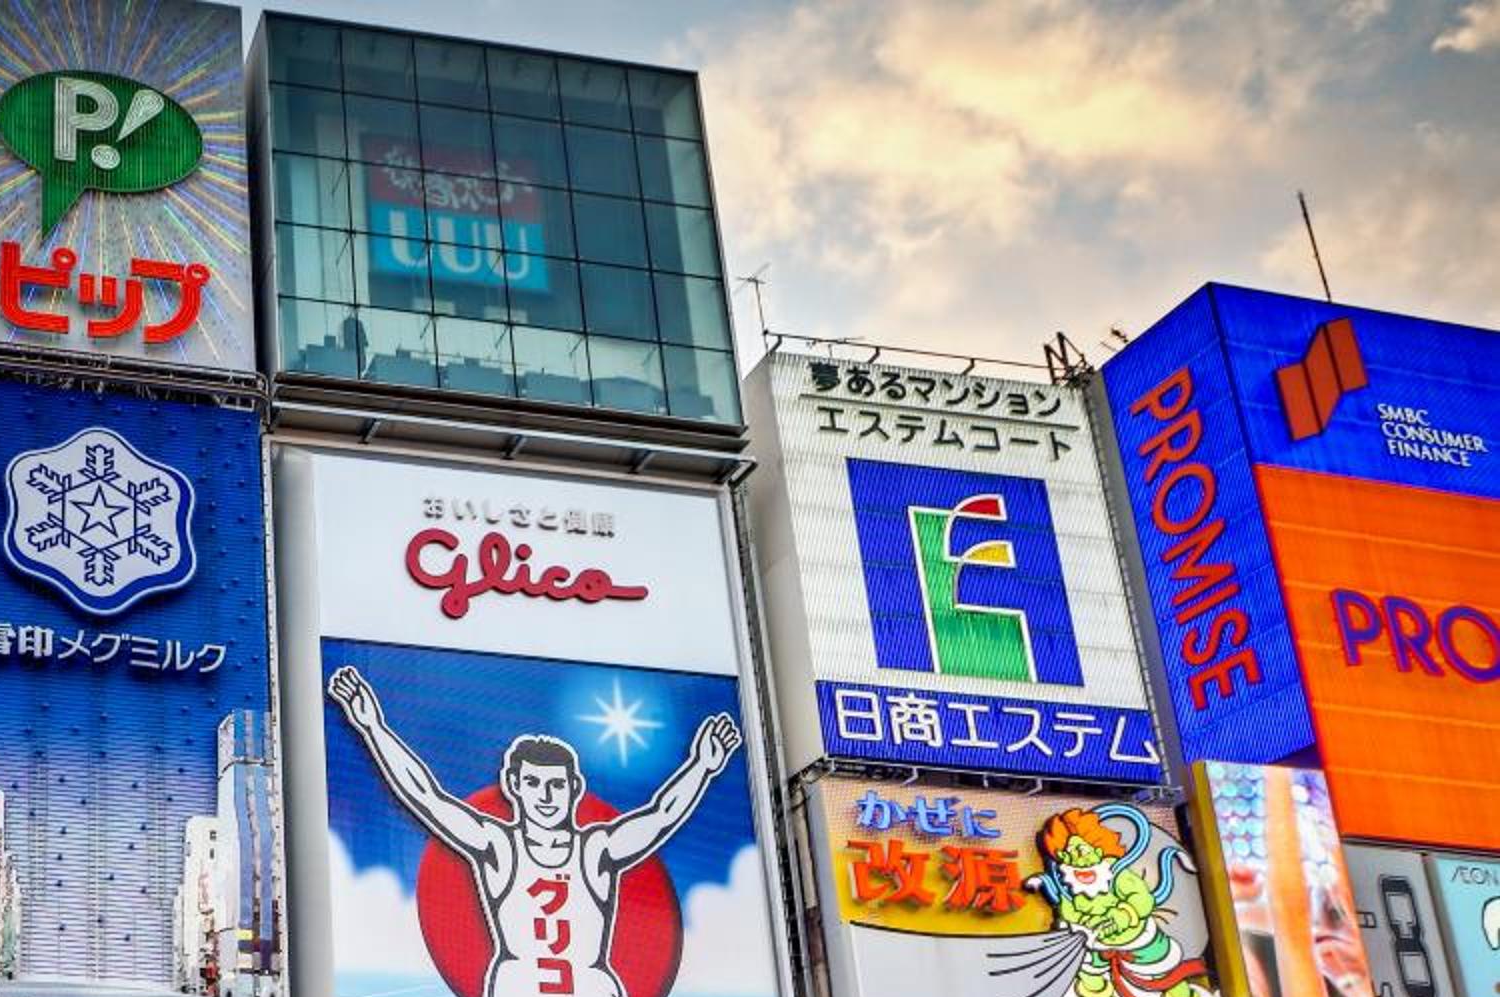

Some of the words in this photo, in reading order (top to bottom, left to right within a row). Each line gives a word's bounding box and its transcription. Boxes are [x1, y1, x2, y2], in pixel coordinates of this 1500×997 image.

[809, 360, 1062, 417] 夢あるマンション
[1378, 403, 1431, 426] SMBC
[817, 405, 1072, 462] エステムコート
[1382, 421, 1489, 452] CONSUMER
[1387, 439, 1472, 467] FINANCE
[1130, 366, 1263, 711] PROMISE
[405, 528, 648, 618] Glico
[834, 689, 1161, 765] 日商エステム
[855, 789, 1001, 838] かぜに
[847, 839, 1027, 914] 改源
